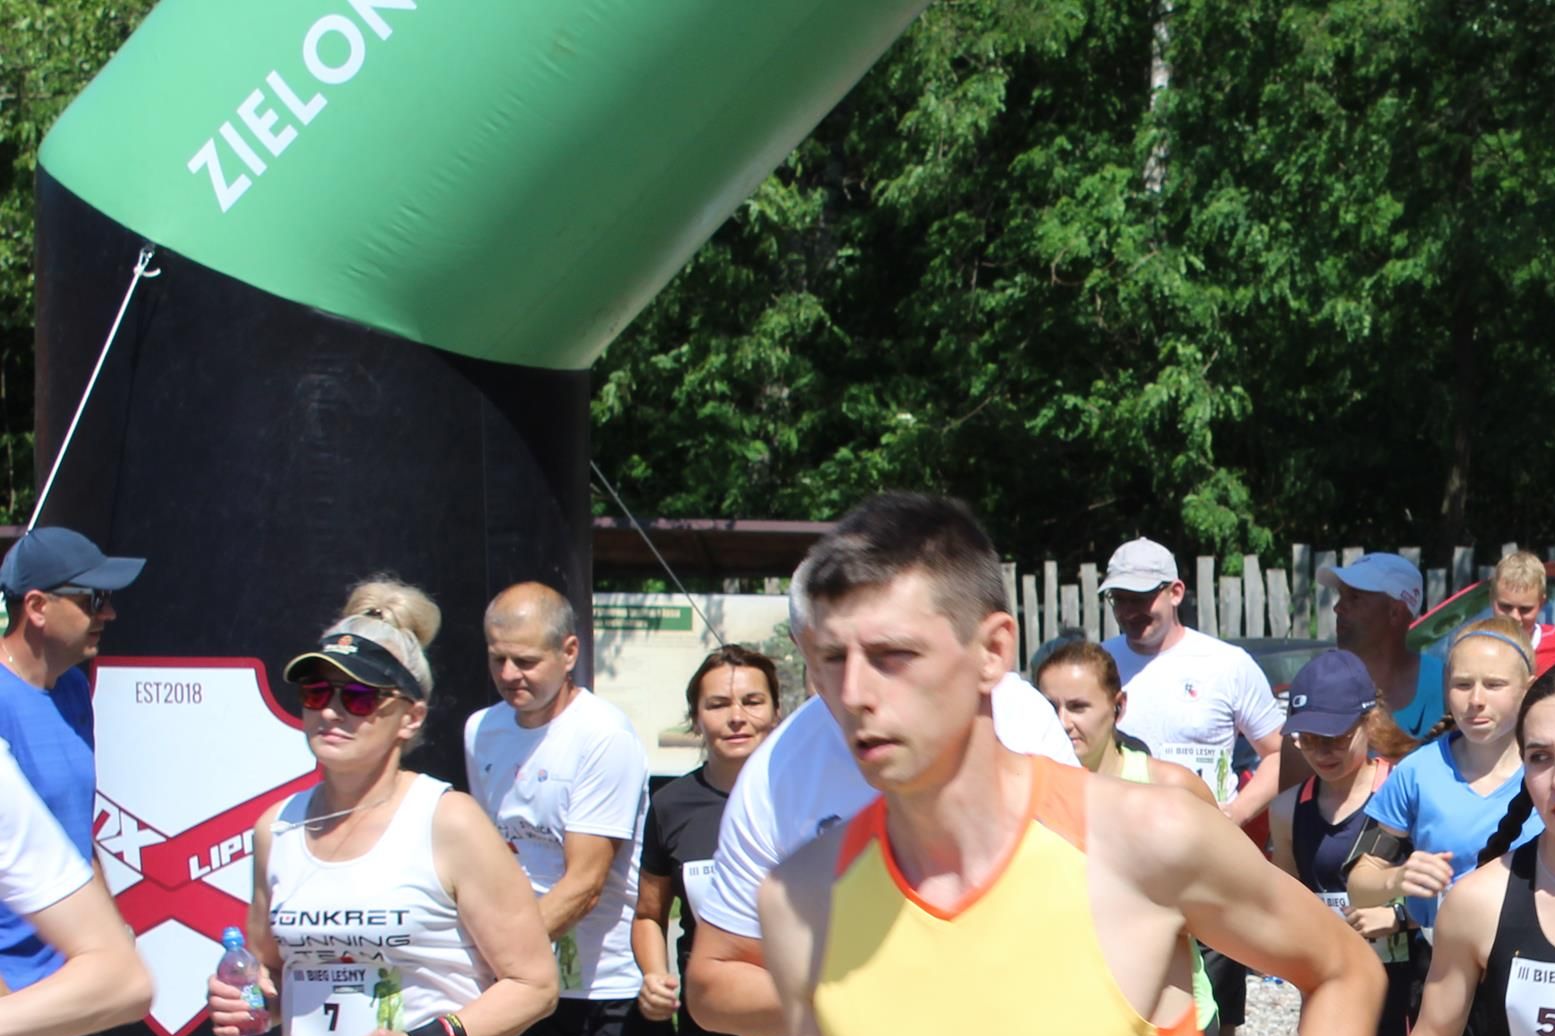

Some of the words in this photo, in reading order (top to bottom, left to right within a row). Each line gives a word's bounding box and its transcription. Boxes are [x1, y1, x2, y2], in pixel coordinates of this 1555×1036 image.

[135, 681, 203, 704] EST2018
[307, 970, 329, 982] BIEG
[332, 967, 366, 983] LEŚNY
[1518, 966, 1530, 981] III
[324, 1003, 340, 1031] 7
